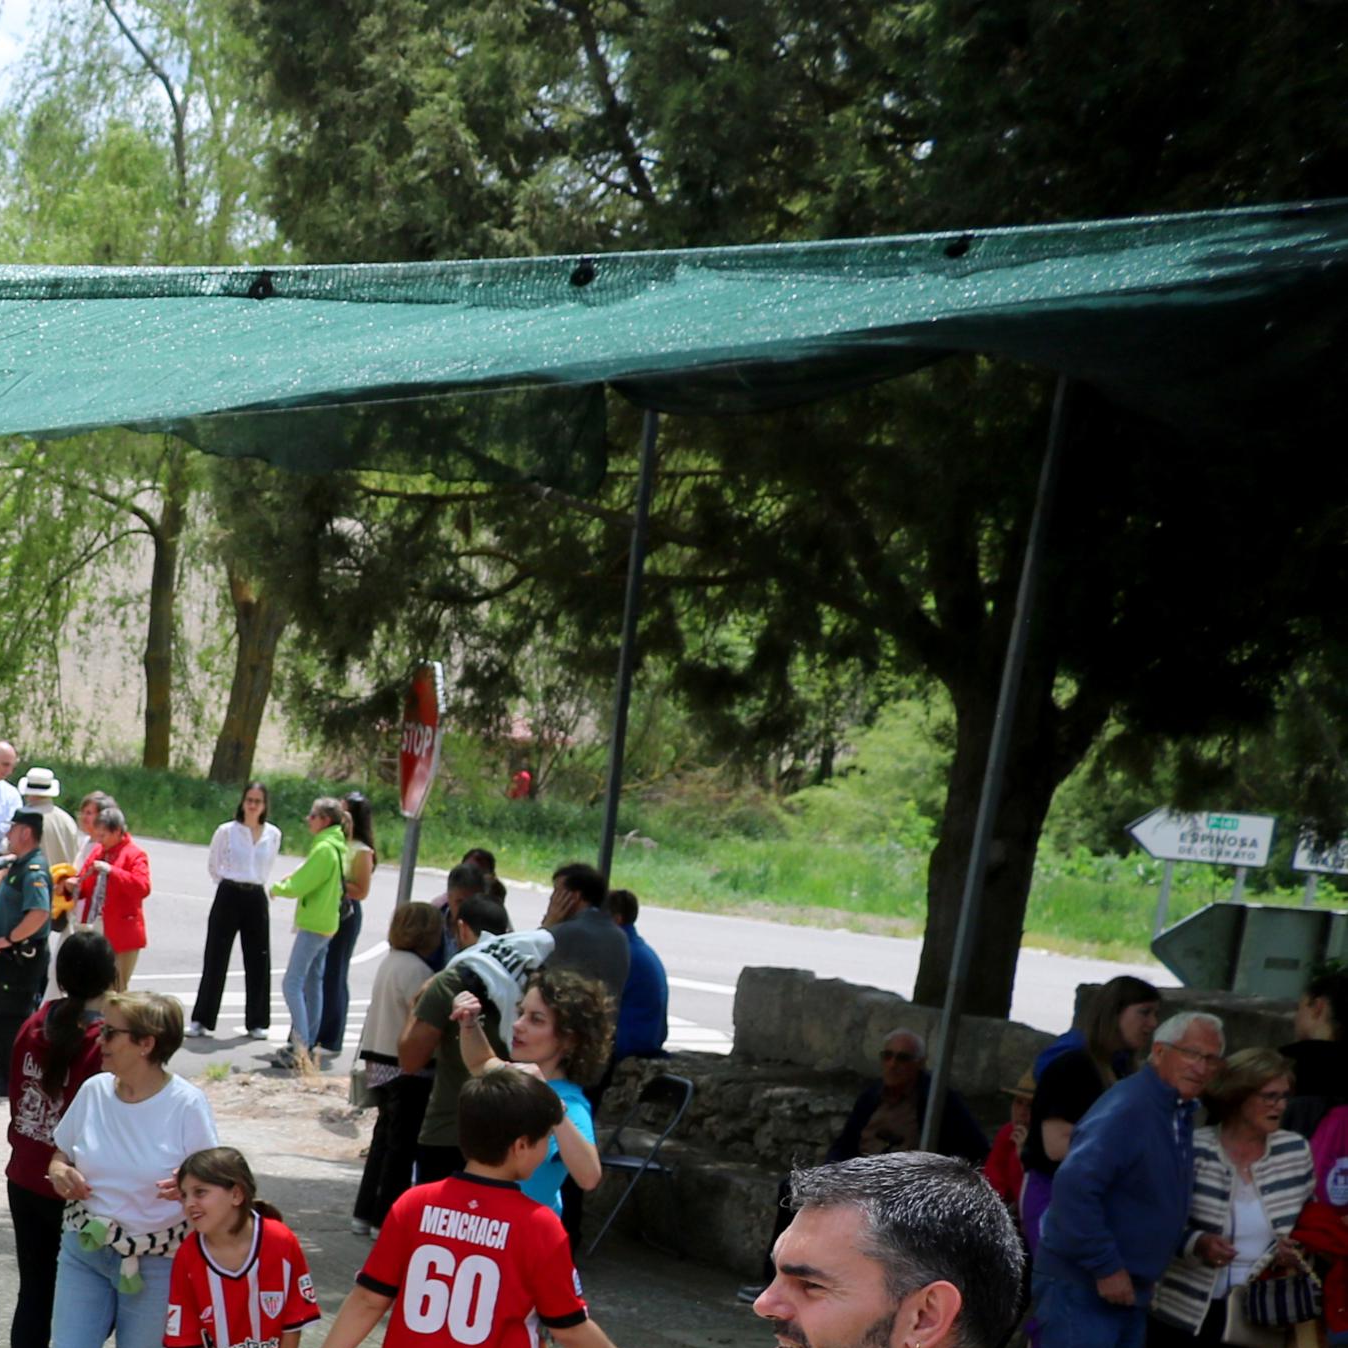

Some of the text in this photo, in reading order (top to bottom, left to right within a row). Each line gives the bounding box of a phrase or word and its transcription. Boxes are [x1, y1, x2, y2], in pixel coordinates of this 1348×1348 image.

[402, 722, 433, 758] STOP
[1179, 832, 1259, 849] ESPINOSA
[1201, 848, 1256, 860] CERRATO
[419, 1205, 510, 1250] MENCHACA
[403, 1244, 501, 1346] 60
